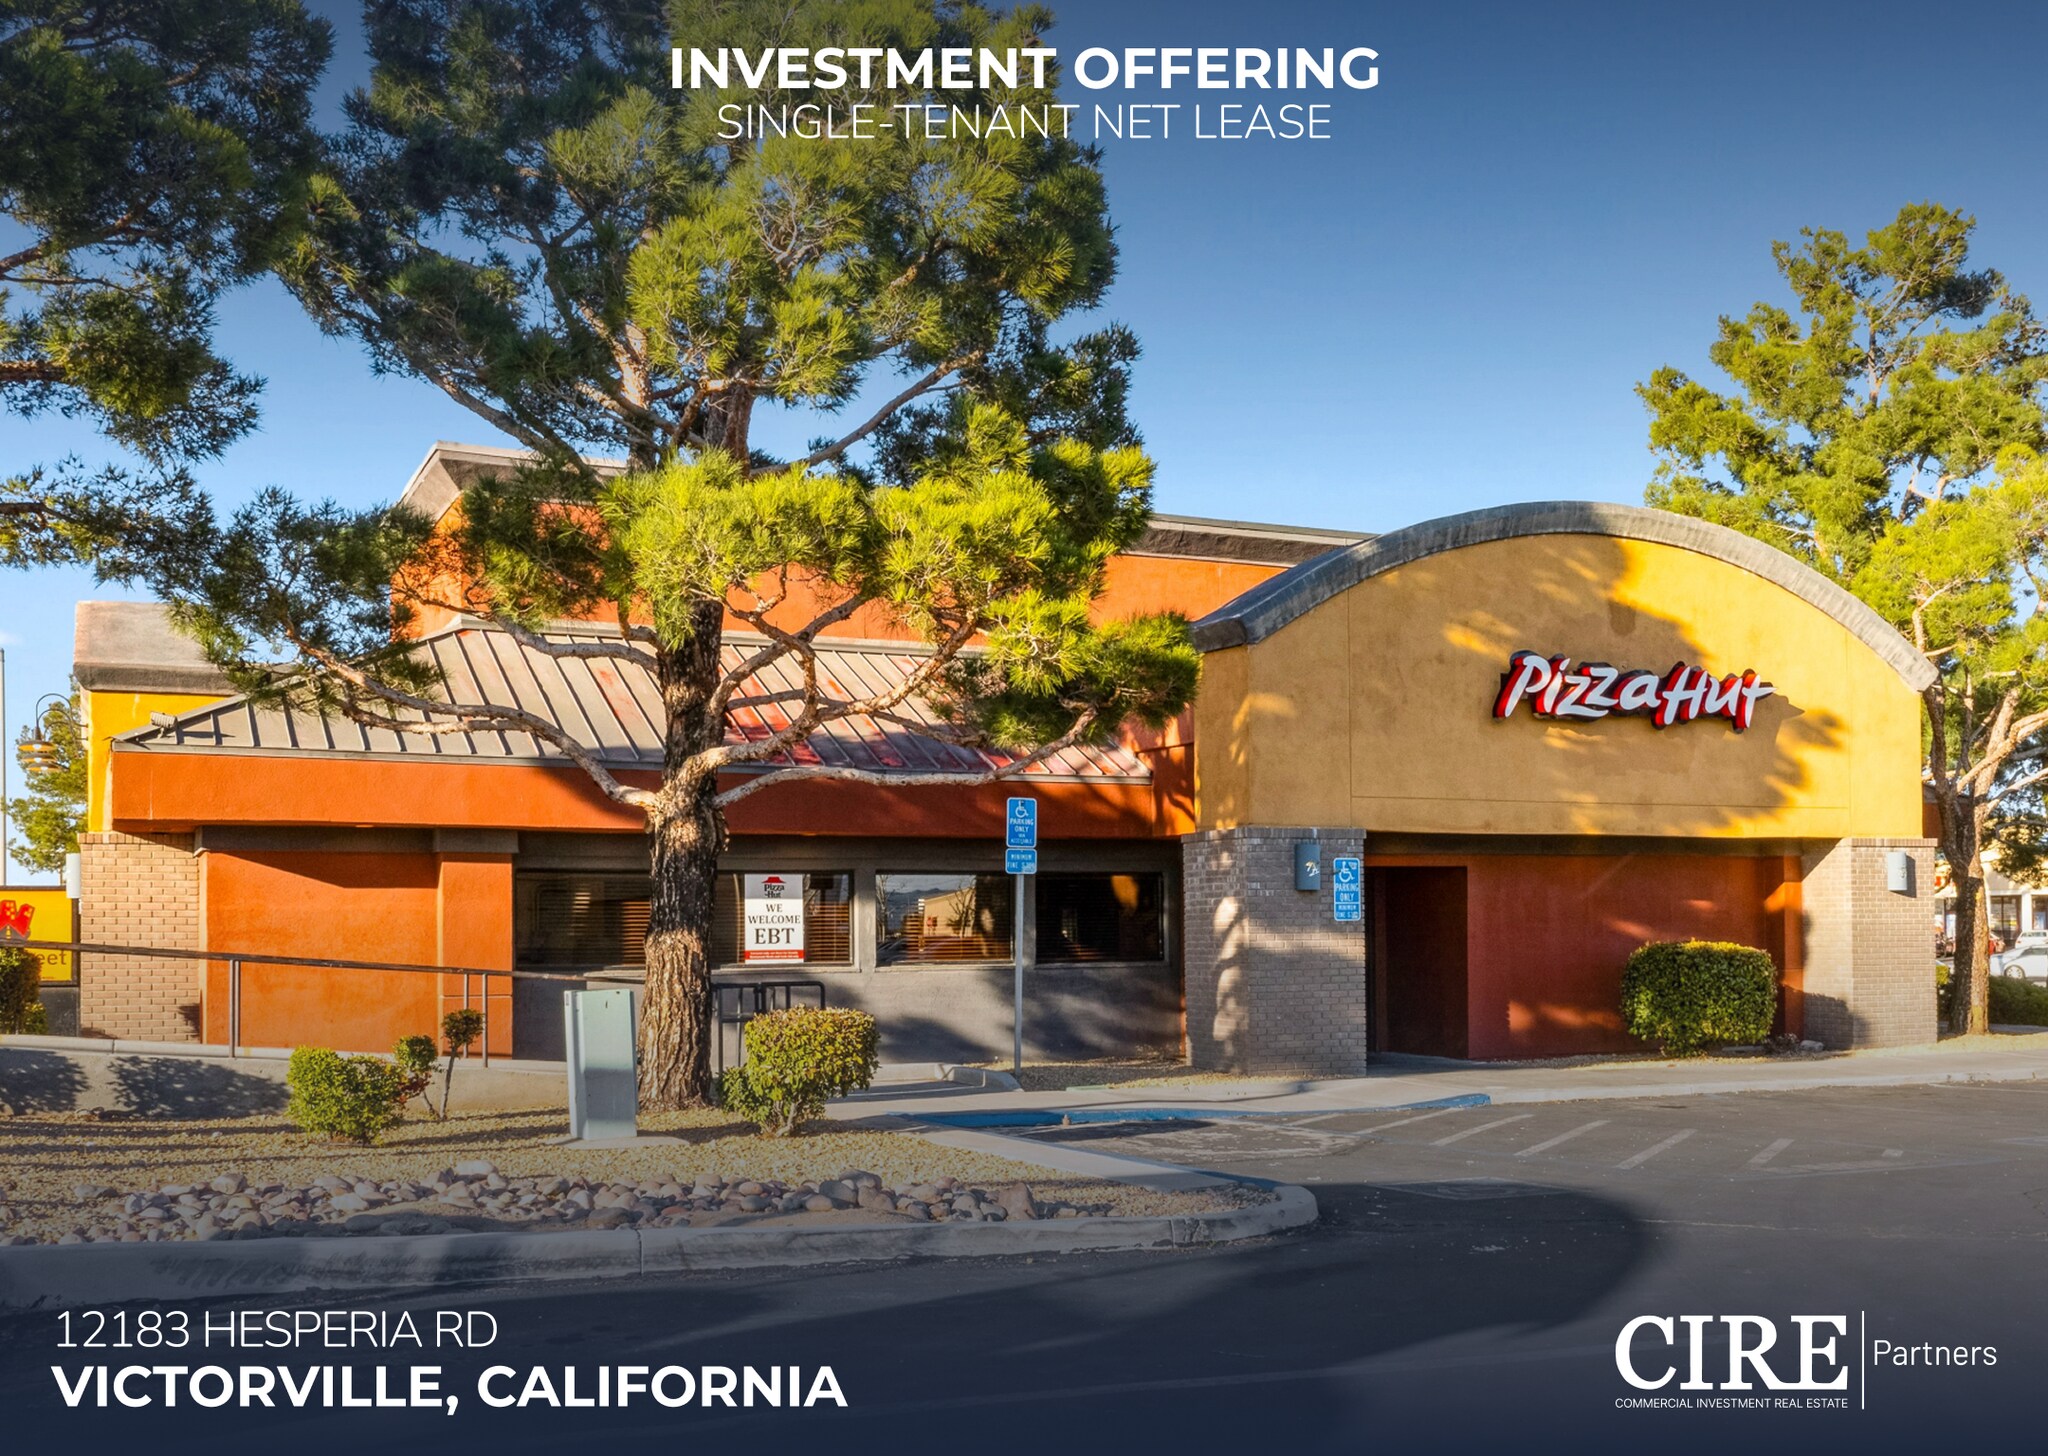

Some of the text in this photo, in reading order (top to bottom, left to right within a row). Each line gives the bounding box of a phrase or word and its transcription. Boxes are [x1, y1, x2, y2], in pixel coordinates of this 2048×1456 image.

[1495, 652, 1777, 730] Pizza Hut
[1010, 818, 1034, 826] PARKING
[764, 883, 785, 892] Pizza
[1335, 883, 1359, 892] PARKING
[1340, 892, 1354, 902] ONLY
[766, 904, 783, 912] WE
[748, 915, 801, 924] WELCOME
[755, 928, 795, 944] EBT
